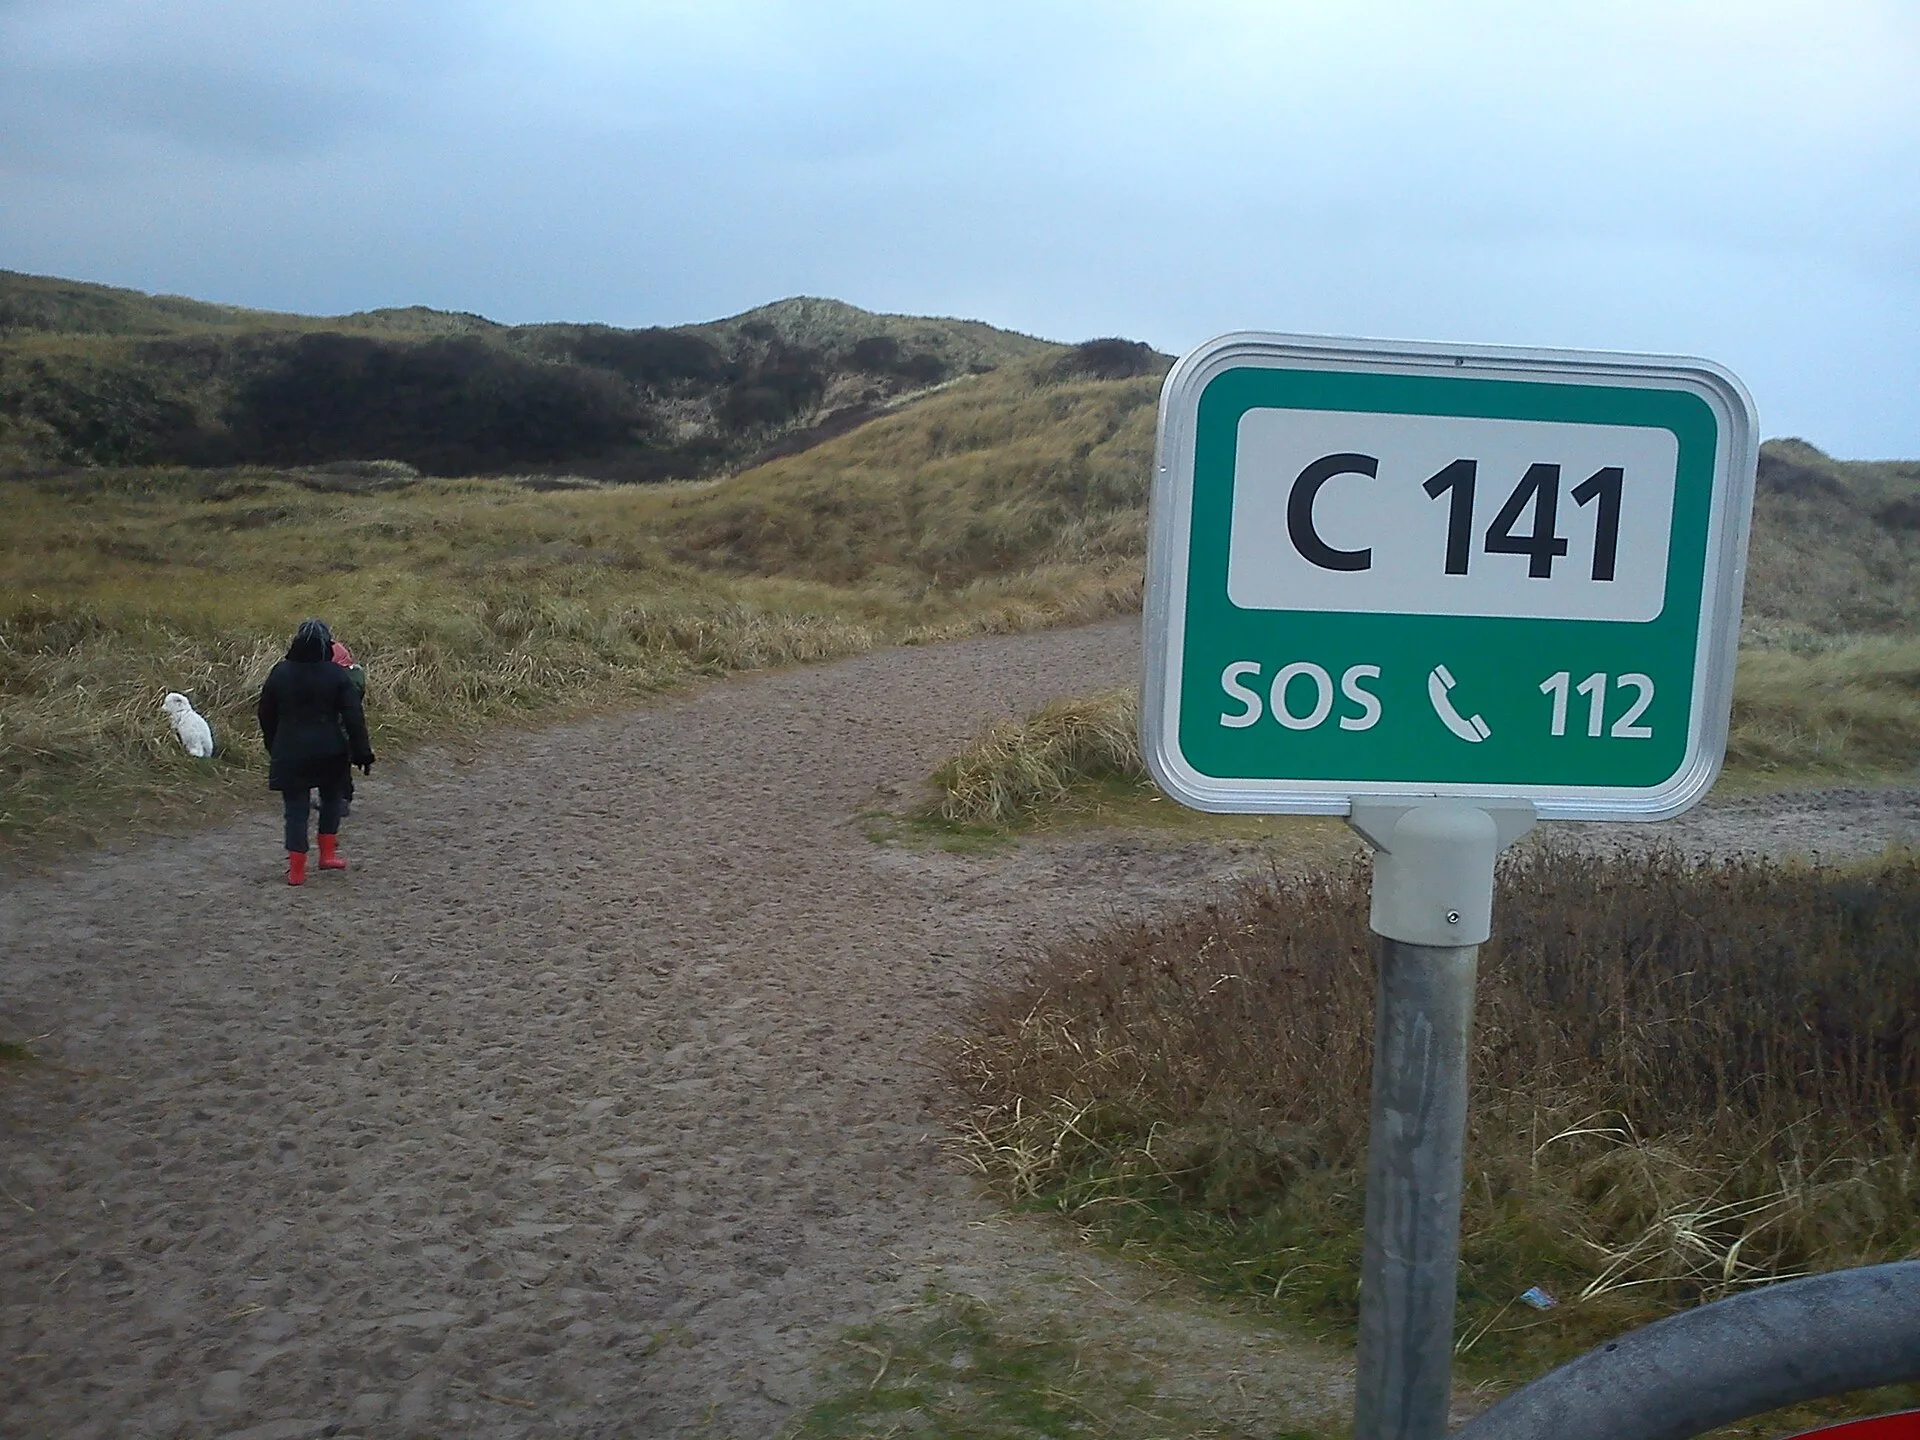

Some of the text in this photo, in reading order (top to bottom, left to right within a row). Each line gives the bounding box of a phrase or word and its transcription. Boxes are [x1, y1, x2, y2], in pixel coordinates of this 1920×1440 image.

[1286, 452, 1625, 582] C 141
[1220, 661, 1655, 738] SOS 112
